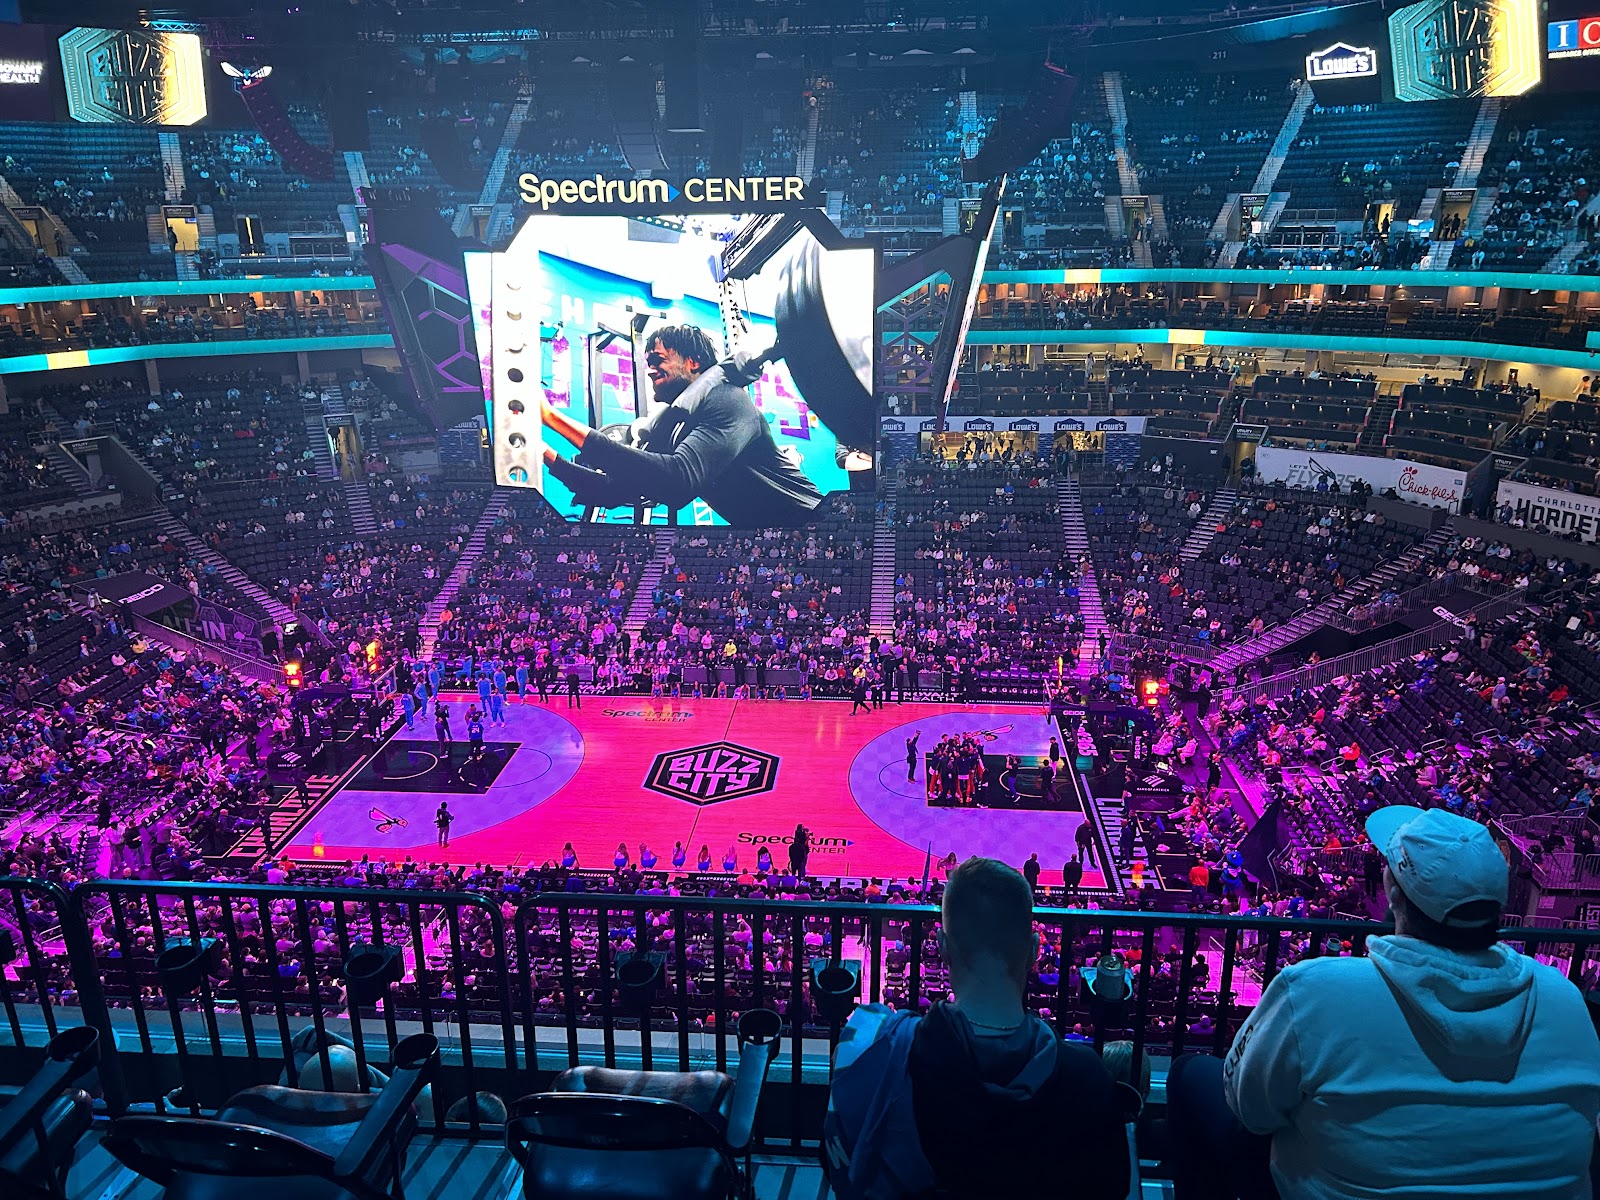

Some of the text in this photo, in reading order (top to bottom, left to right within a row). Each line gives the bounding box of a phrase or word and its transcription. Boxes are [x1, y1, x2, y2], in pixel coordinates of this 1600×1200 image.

[1212, 51, 1226, 59] 211
[1313, 55, 1370, 75] LOWE'S
[518, 173, 804, 210] Spectrum CENTER
[882, 423, 903, 431] OWE'S
[967, 423, 992, 431] LOWE'S
[1011, 423, 1037, 431] LOWE'S
[1056, 423, 1082, 431] LOWE'S
[1099, 423, 1124, 431] LOWE'S
[1286, 469, 1320, 484] FLY
[1399, 472, 1458, 501] Chick-fil-A
[602, 708, 689, 719] Spectrum
[669, 749, 761, 773] BUZZ
[668, 772, 751, 797] CITY
